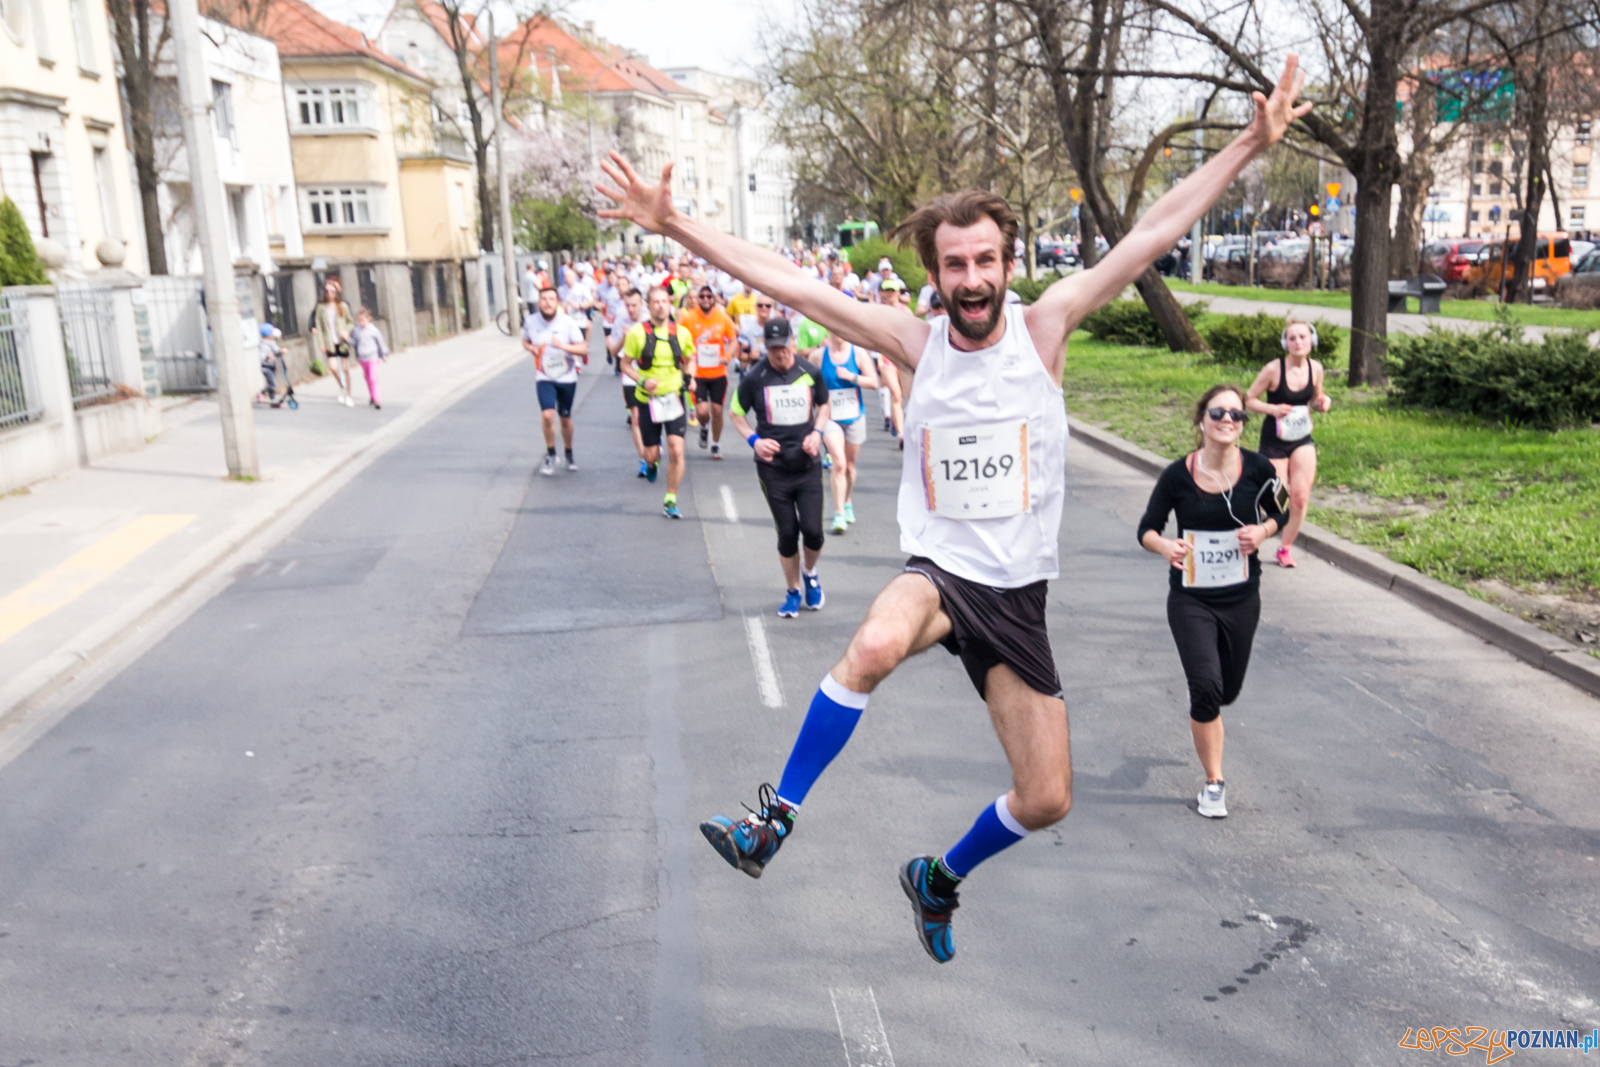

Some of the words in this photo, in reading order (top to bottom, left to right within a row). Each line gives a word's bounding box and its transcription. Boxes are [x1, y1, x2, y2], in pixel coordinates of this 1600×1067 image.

[775, 397, 806, 409] 11350
[940, 454, 1014, 481] 12169
[1200, 548, 1239, 564] 12291
